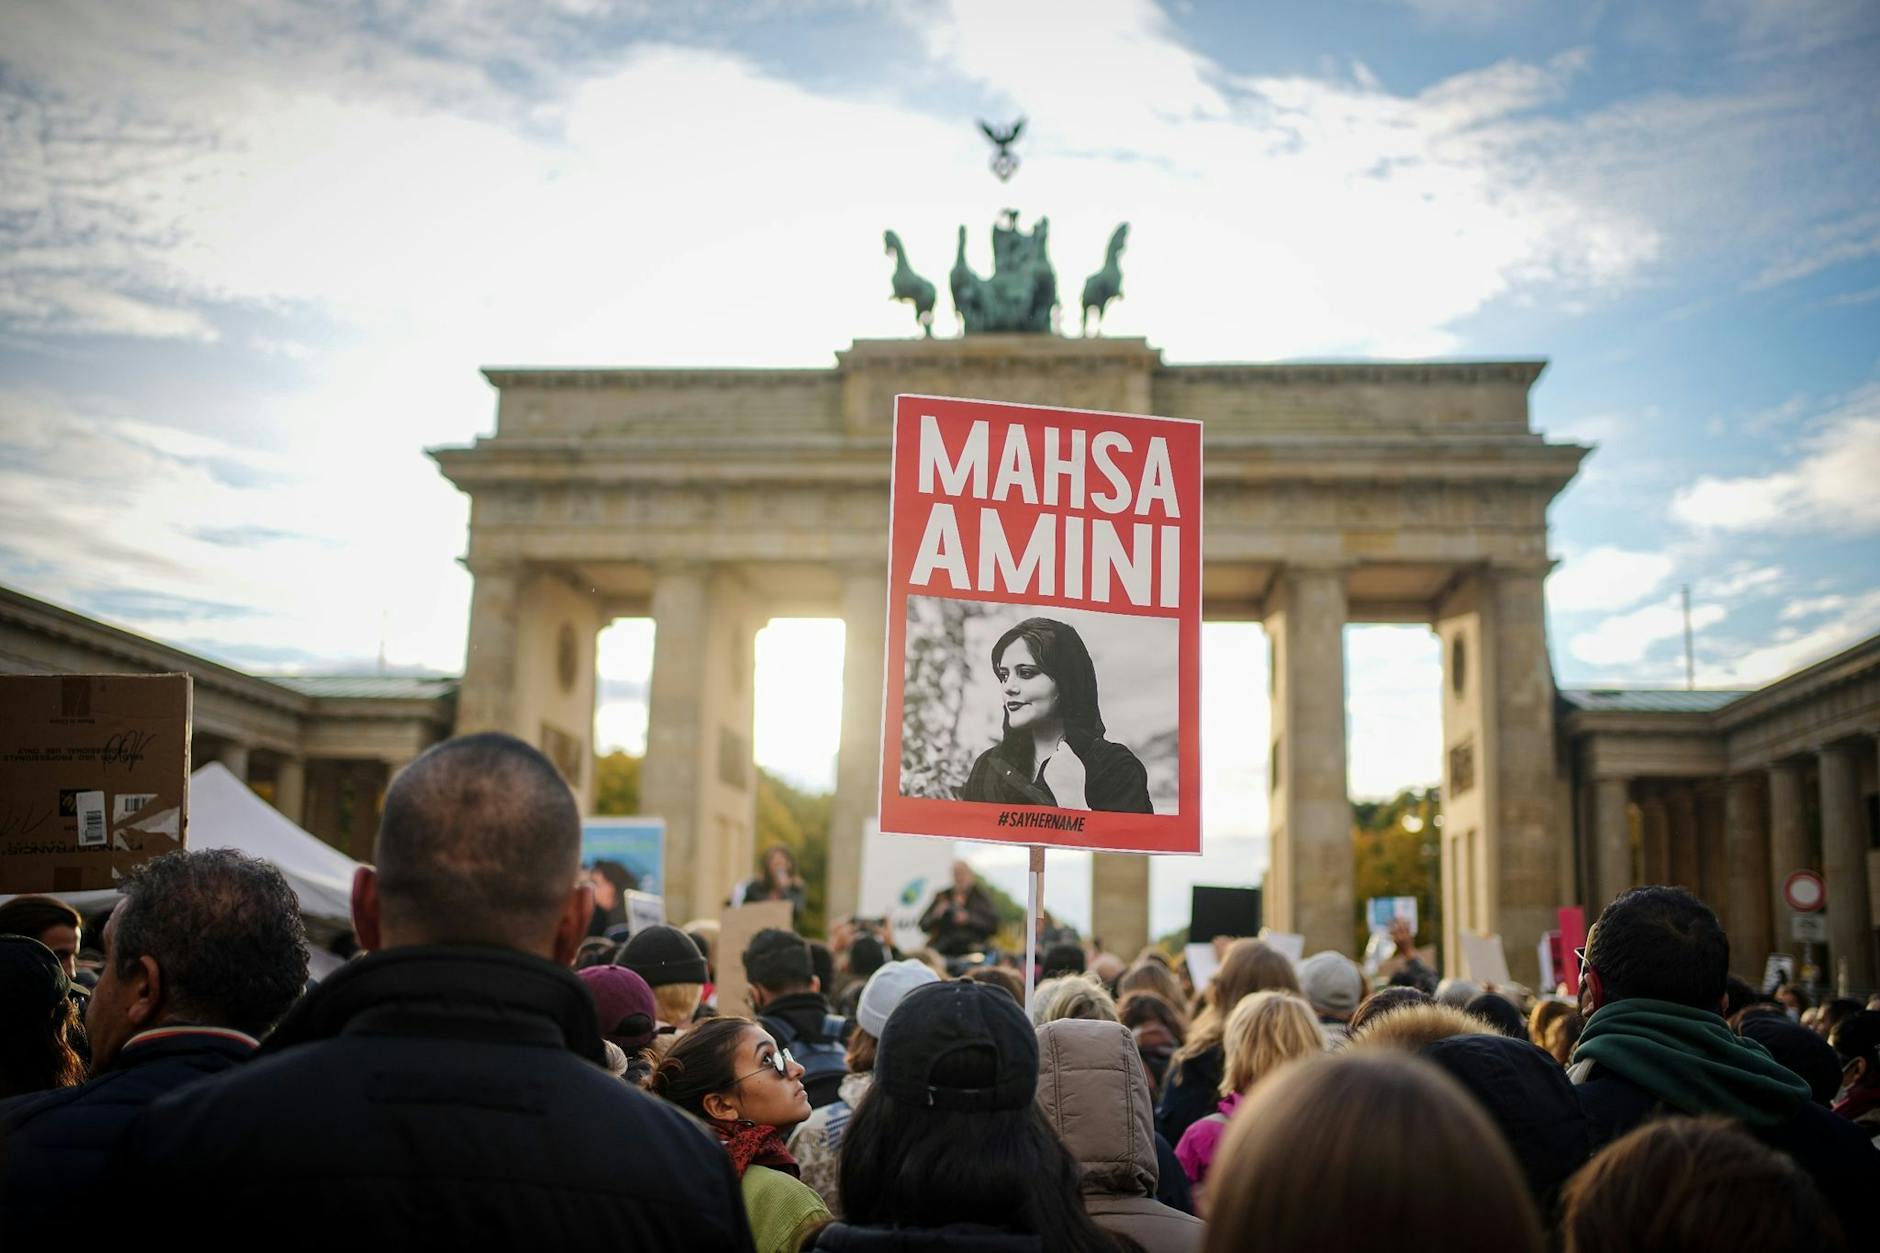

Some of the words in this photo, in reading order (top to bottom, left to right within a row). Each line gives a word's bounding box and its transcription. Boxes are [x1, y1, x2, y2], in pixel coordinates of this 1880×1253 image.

[918, 415, 1180, 518] MAHSA
[909, 503, 1180, 608] AMINI
[998, 811, 1085, 832] #SAYHERNAME
